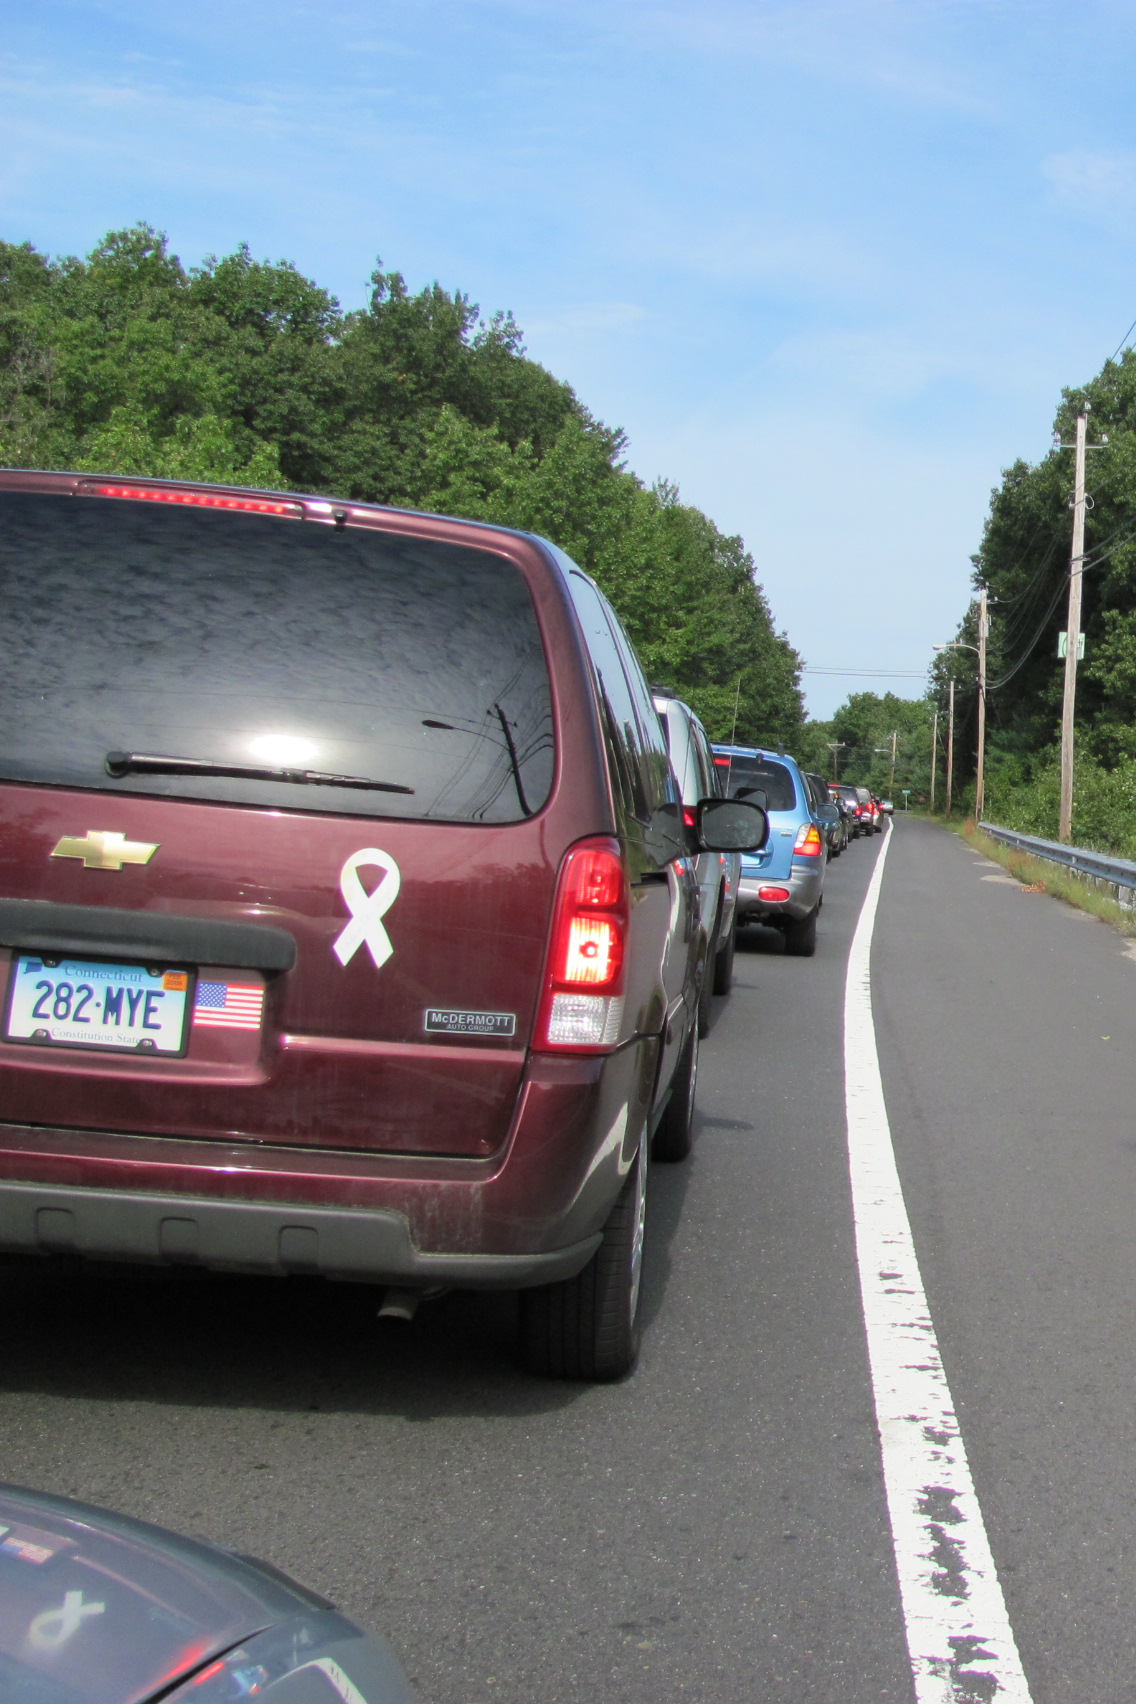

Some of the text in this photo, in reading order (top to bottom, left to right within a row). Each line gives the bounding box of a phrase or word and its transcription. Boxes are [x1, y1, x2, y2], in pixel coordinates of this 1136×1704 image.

[64, 965, 143, 983] Connecticut
[432, 1012, 510, 1026] McDERMOTT
[51, 1027, 114, 1042] Constitution
